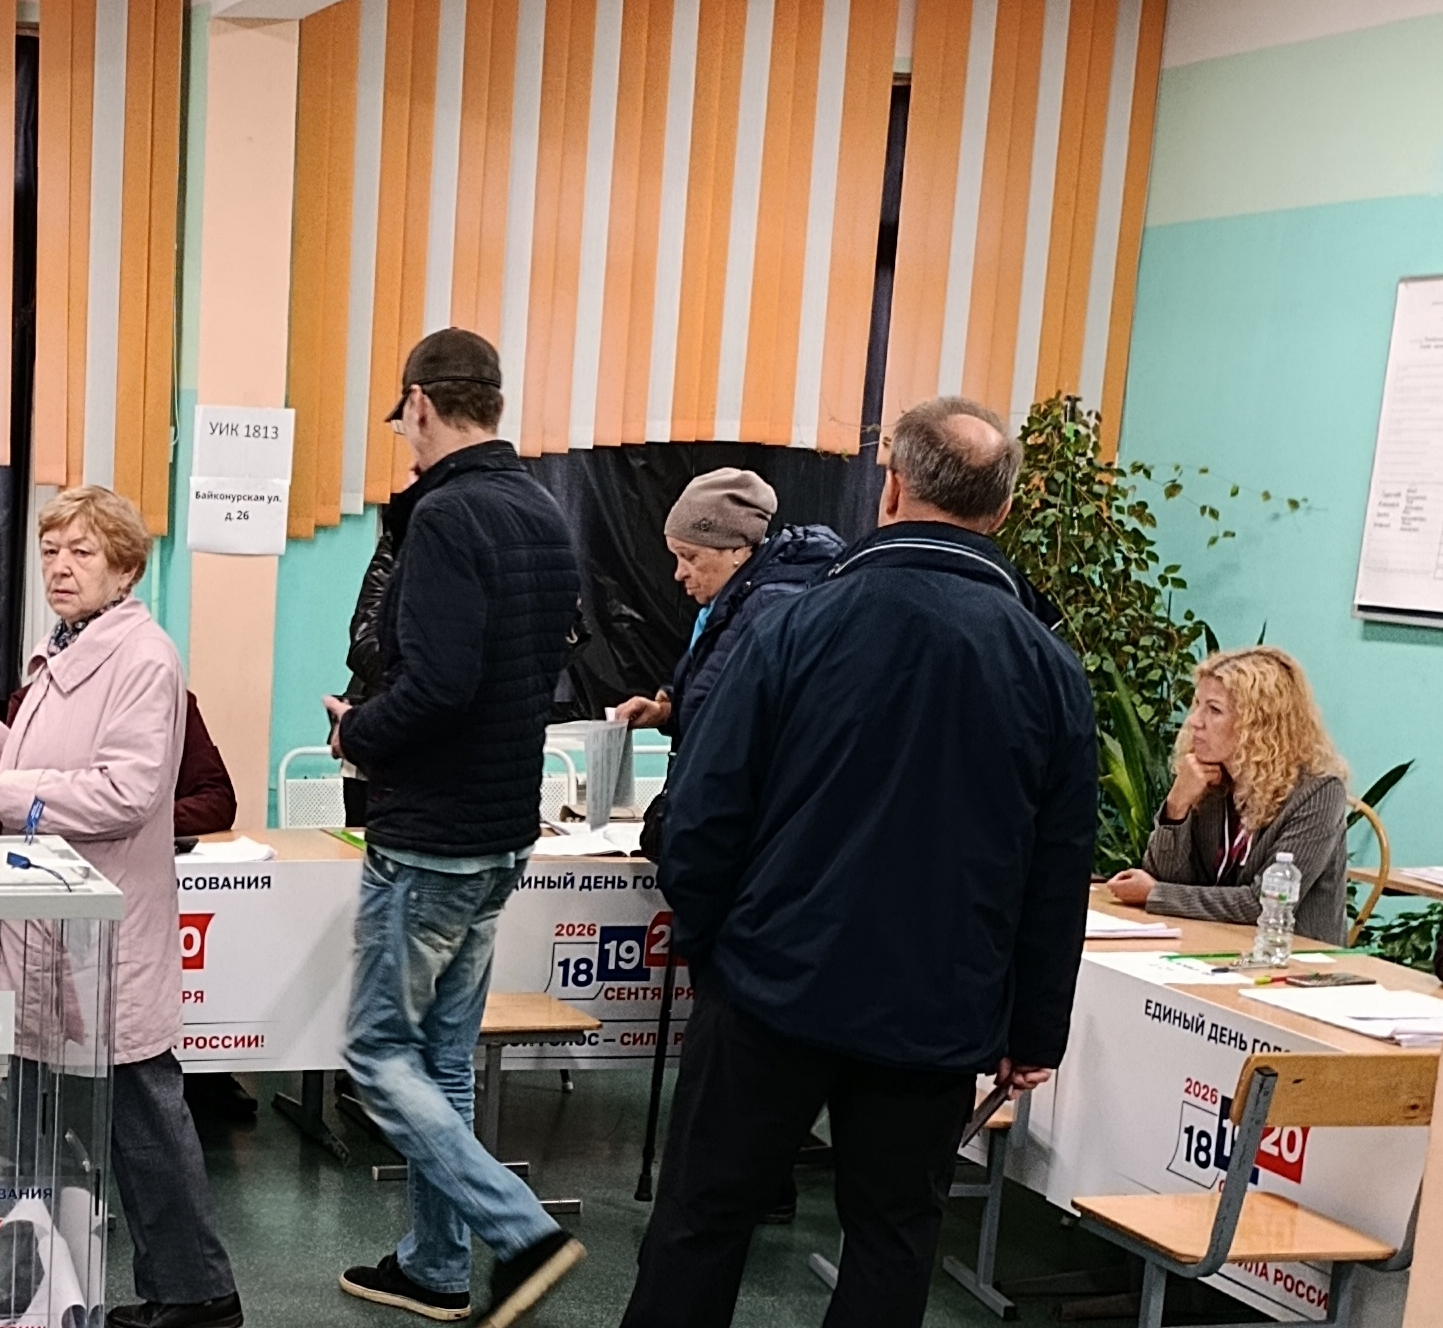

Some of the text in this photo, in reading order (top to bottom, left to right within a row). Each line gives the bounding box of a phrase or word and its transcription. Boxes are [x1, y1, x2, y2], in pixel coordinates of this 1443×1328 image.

[209, 422, 279, 440] УИК 1813
[195, 491, 282, 504] Байконурская ул.
[224, 510, 250, 522] д. 26
[176, 876, 272, 890] СОВАНИЯ
[514, 872, 575, 891] ИНЫЙ
[579, 876, 628, 891] ДЕНЬ
[554, 923, 597, 937] 2026
[604, 940, 641, 970] 19
[557, 957, 594, 987] 18
[604, 987, 696, 1001] СЕНТЯРЯ
[1144, 998, 1206, 1037] ЕДИНЫЙ
[1207, 1022, 1248, 1052] ДЕНЬ
[183, 1035, 265, 1050] РОССИИ!
[1184, 1077, 1218, 1105] 2026
[1183, 1124, 1212, 1169] 18
[1260, 1127, 1303, 1164] 20
[1273, 1268, 1329, 1311] РОССИ
